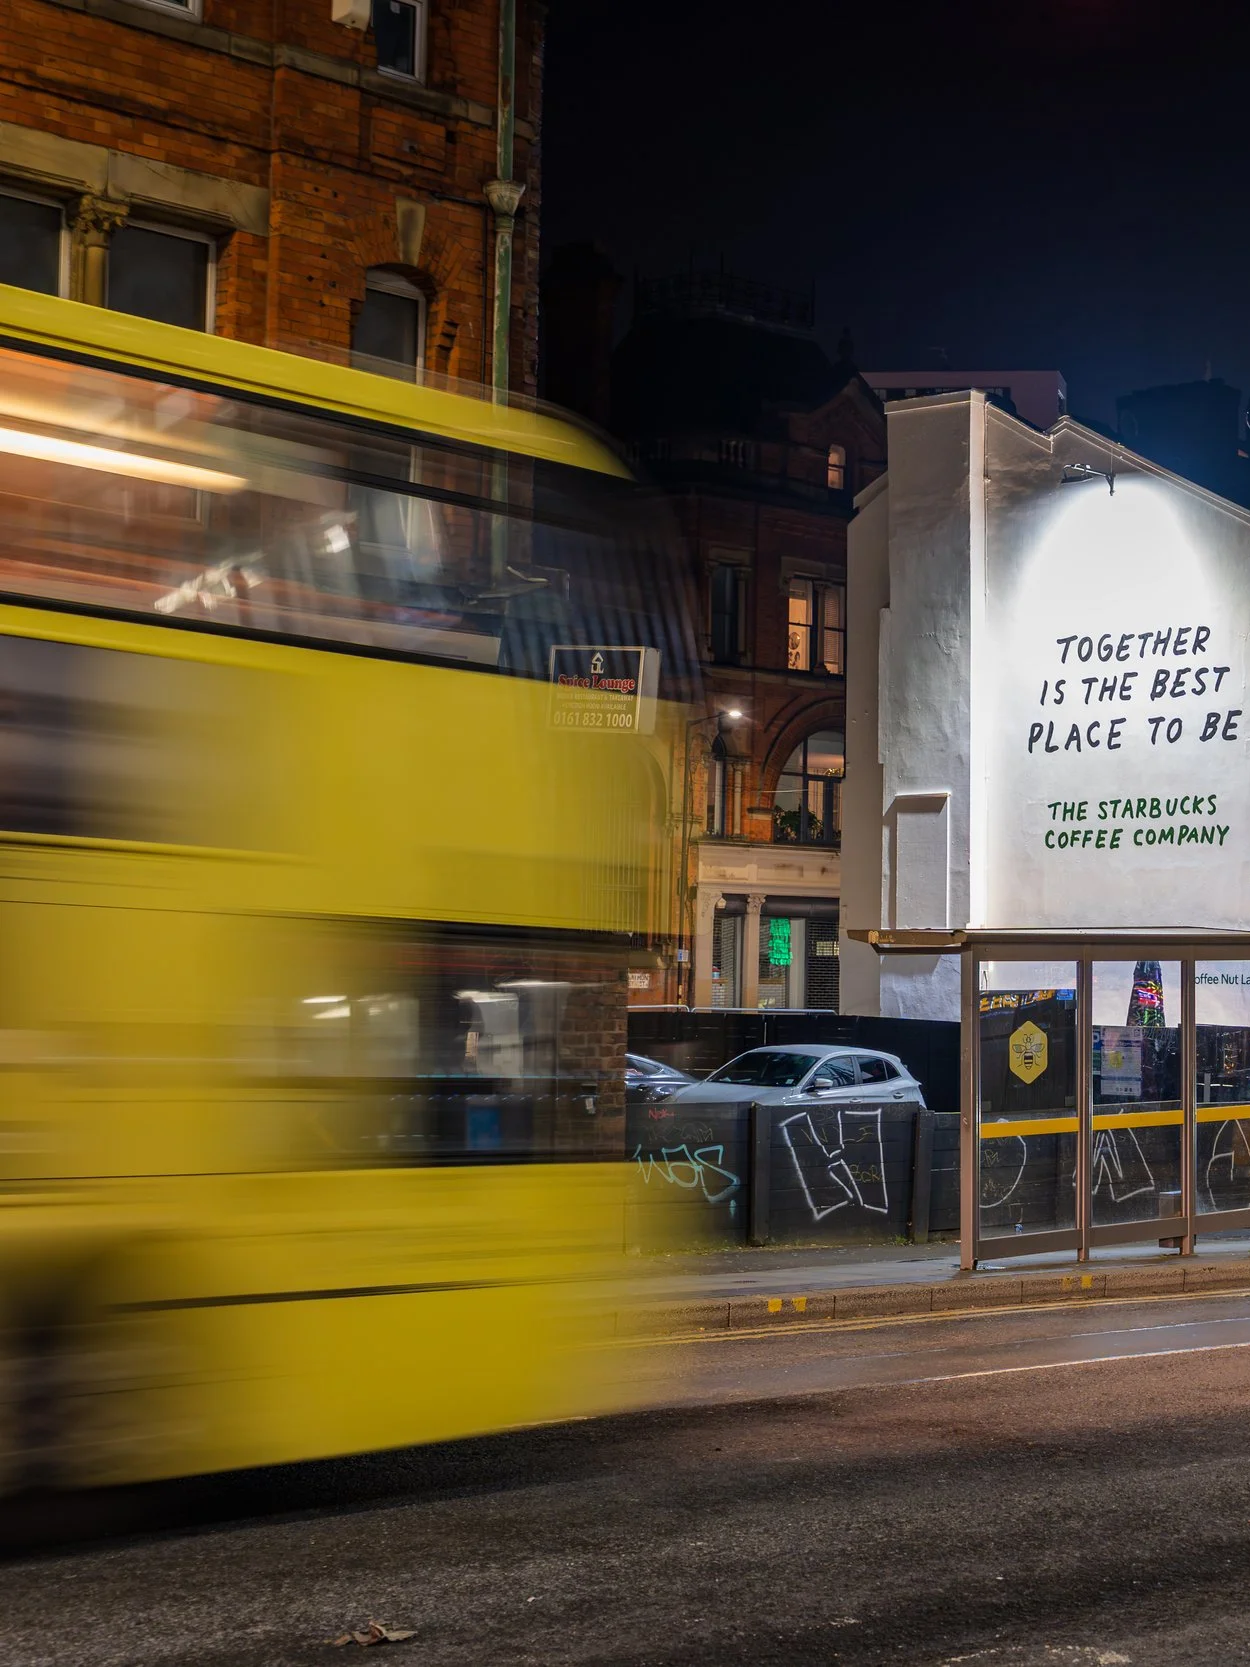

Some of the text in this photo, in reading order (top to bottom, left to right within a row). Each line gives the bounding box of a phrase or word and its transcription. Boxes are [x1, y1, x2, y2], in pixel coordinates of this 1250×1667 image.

[1056, 625, 1211, 664] TOGETHER
[558, 674, 636, 693] Spice Lounge
[1040, 666, 1230, 706] IS THE BEST
[554, 711, 632, 727] 0161 832 1000
[1028, 709, 1242, 753] PLACE TO BE
[1047, 794, 1217, 822] THE STARBUCKS
[1044, 824, 1230, 850] COFFEE COMPANY
[1195, 973, 1219, 984] offee
[1221, 973, 1239, 985] Nut
